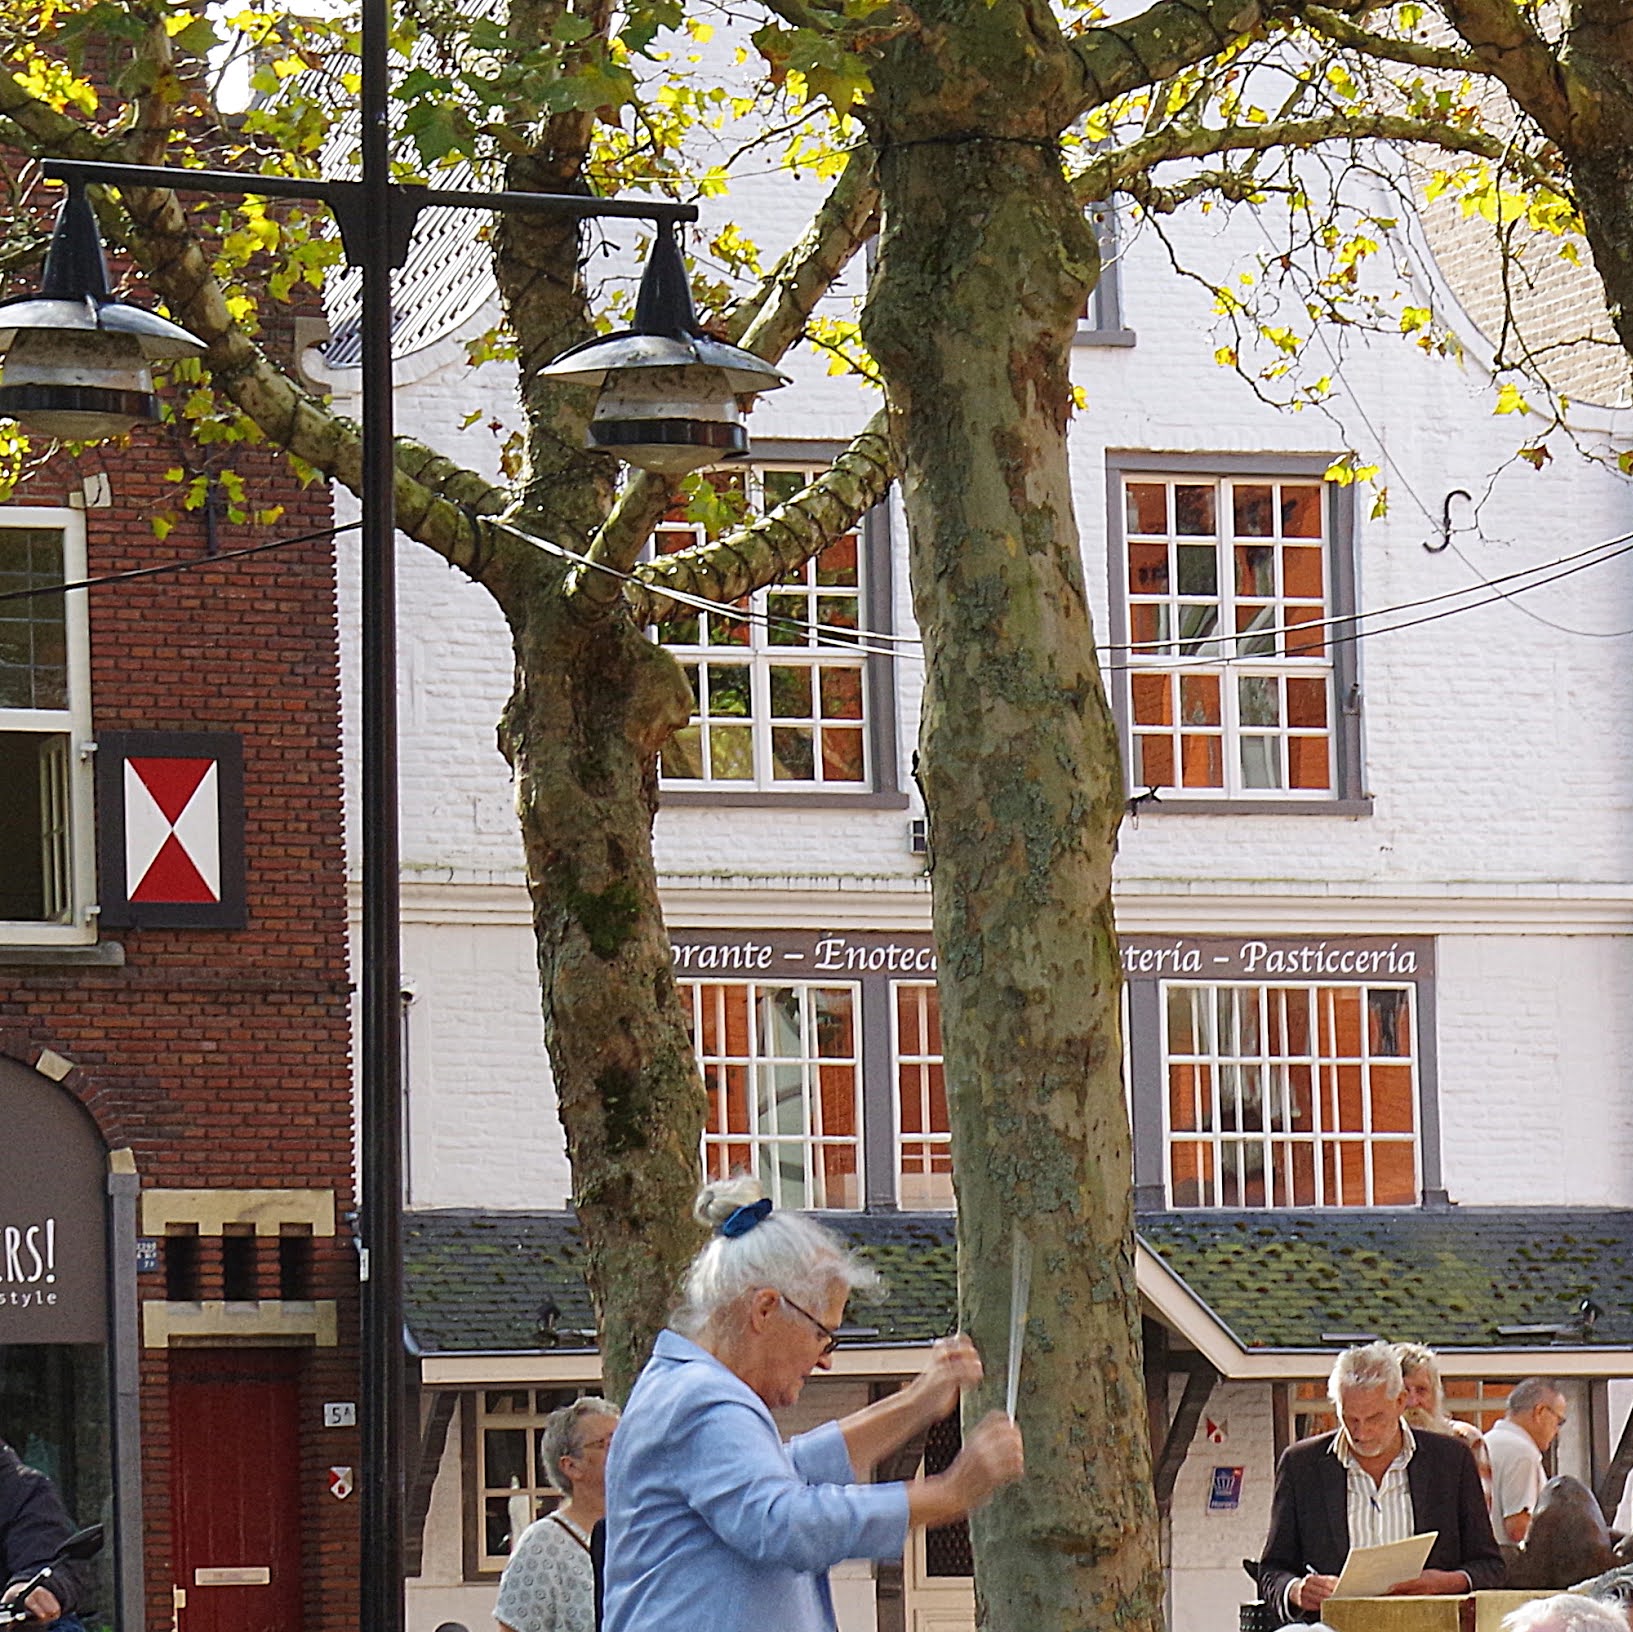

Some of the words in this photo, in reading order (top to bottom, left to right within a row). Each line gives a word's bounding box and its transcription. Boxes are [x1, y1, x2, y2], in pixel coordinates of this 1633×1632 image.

[1119, 940, 1203, 972] teria
[1240, 940, 1417, 974] Pasticceria
[0, 1218, 56, 1284] RS!
